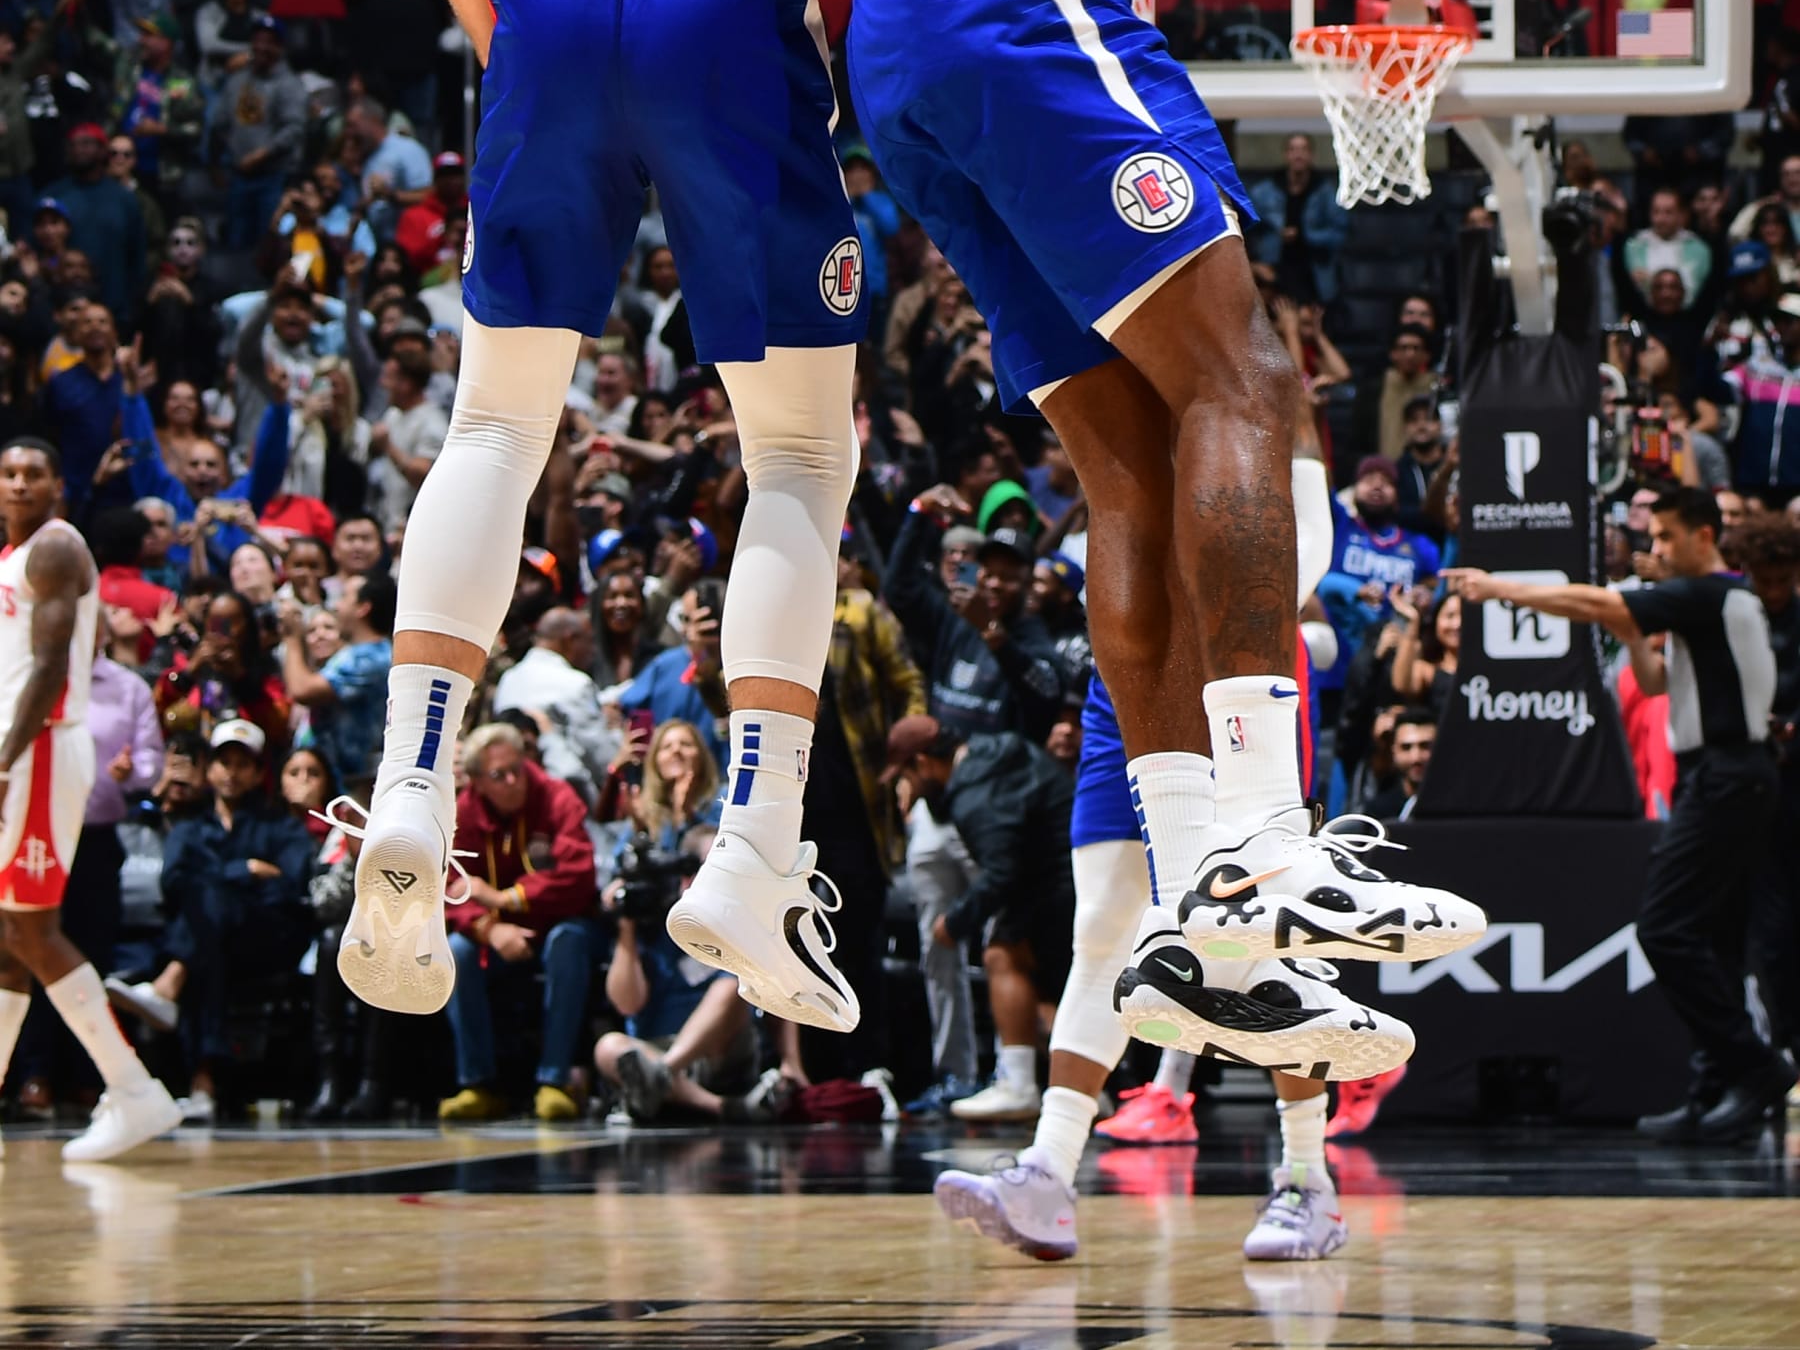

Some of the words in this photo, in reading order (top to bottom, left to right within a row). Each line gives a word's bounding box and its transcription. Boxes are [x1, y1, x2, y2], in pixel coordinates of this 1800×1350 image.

[1472, 502, 1571, 522] PECHANGA
[1460, 675, 1596, 737] honey
[1379, 922, 1656, 994] KIA
